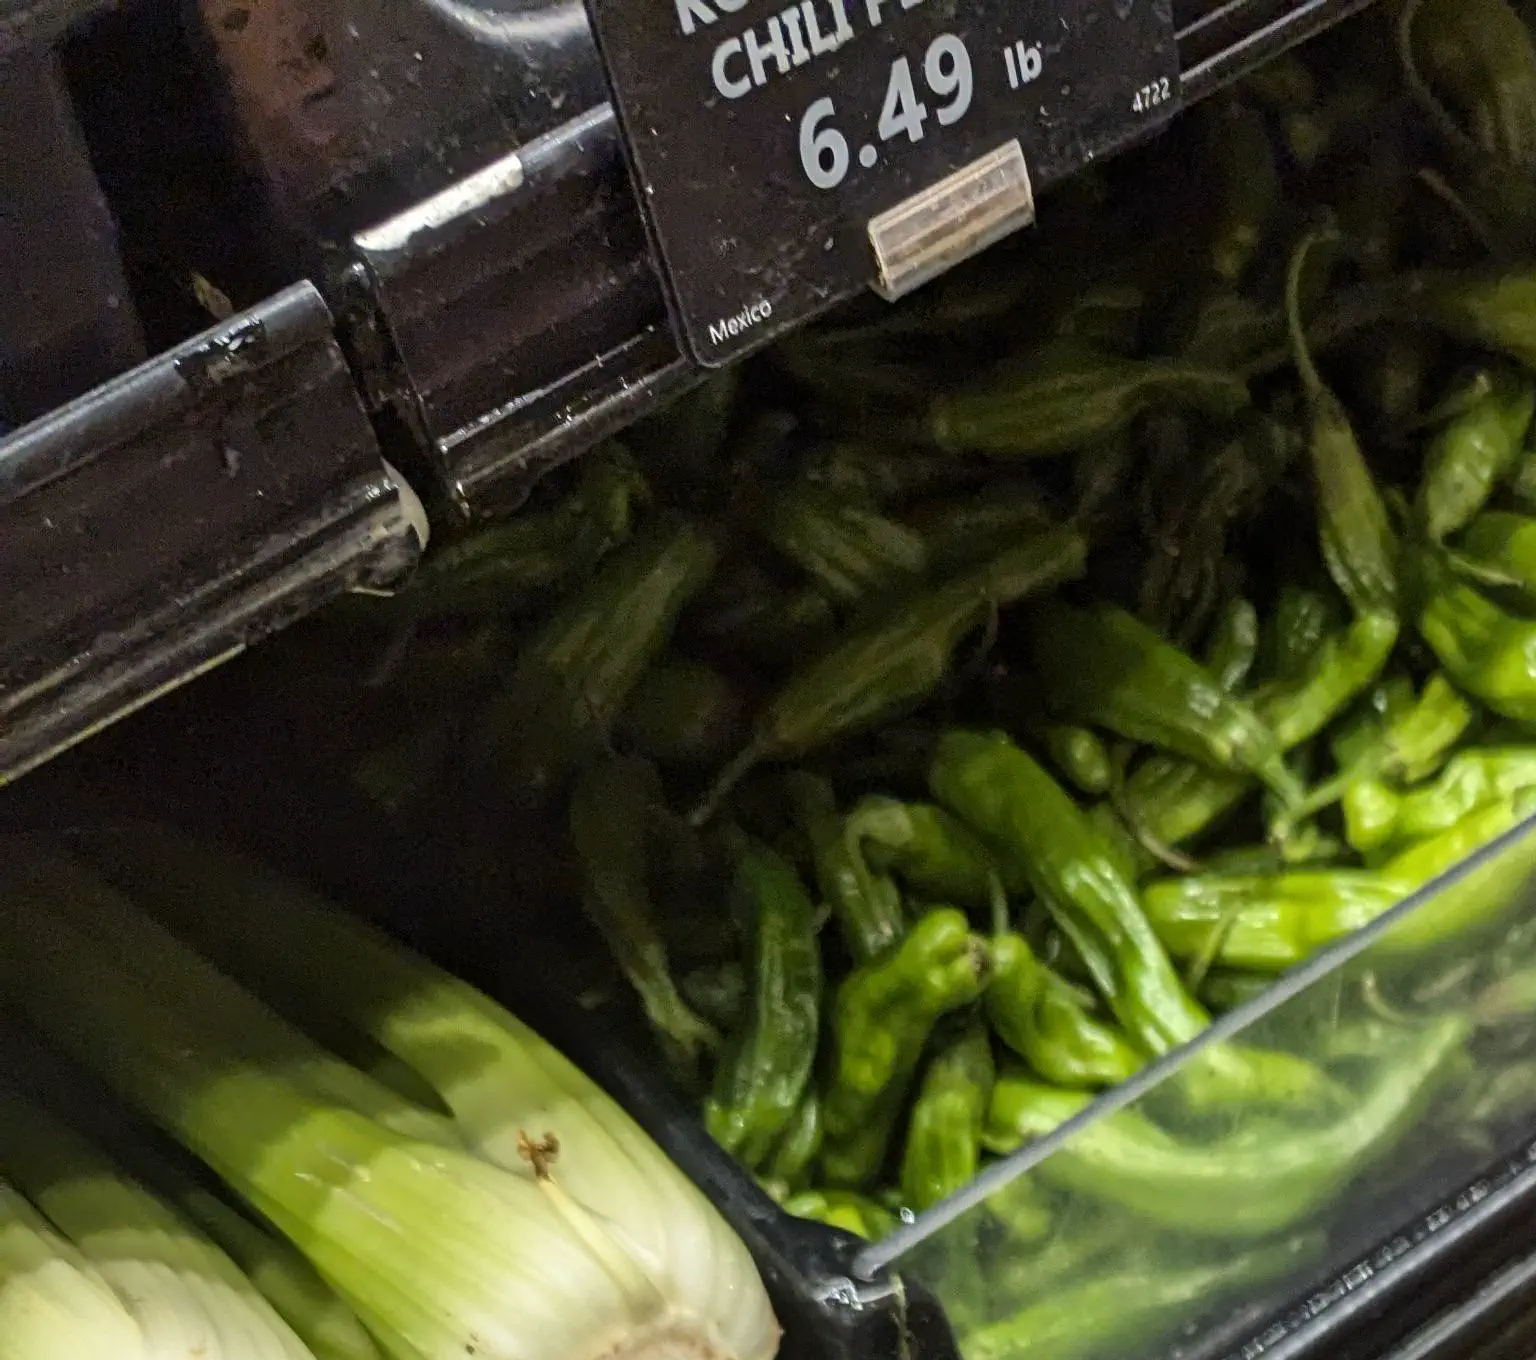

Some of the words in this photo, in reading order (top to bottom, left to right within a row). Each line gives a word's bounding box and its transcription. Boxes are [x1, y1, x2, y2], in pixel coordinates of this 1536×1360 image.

[711, 0, 854, 99] CHILI
[799, 33, 973, 190] 6.49
[1003, 40, 1042, 89] lb
[1132, 76, 1170, 112] 4722
[708, 299, 772, 345] Mexico
